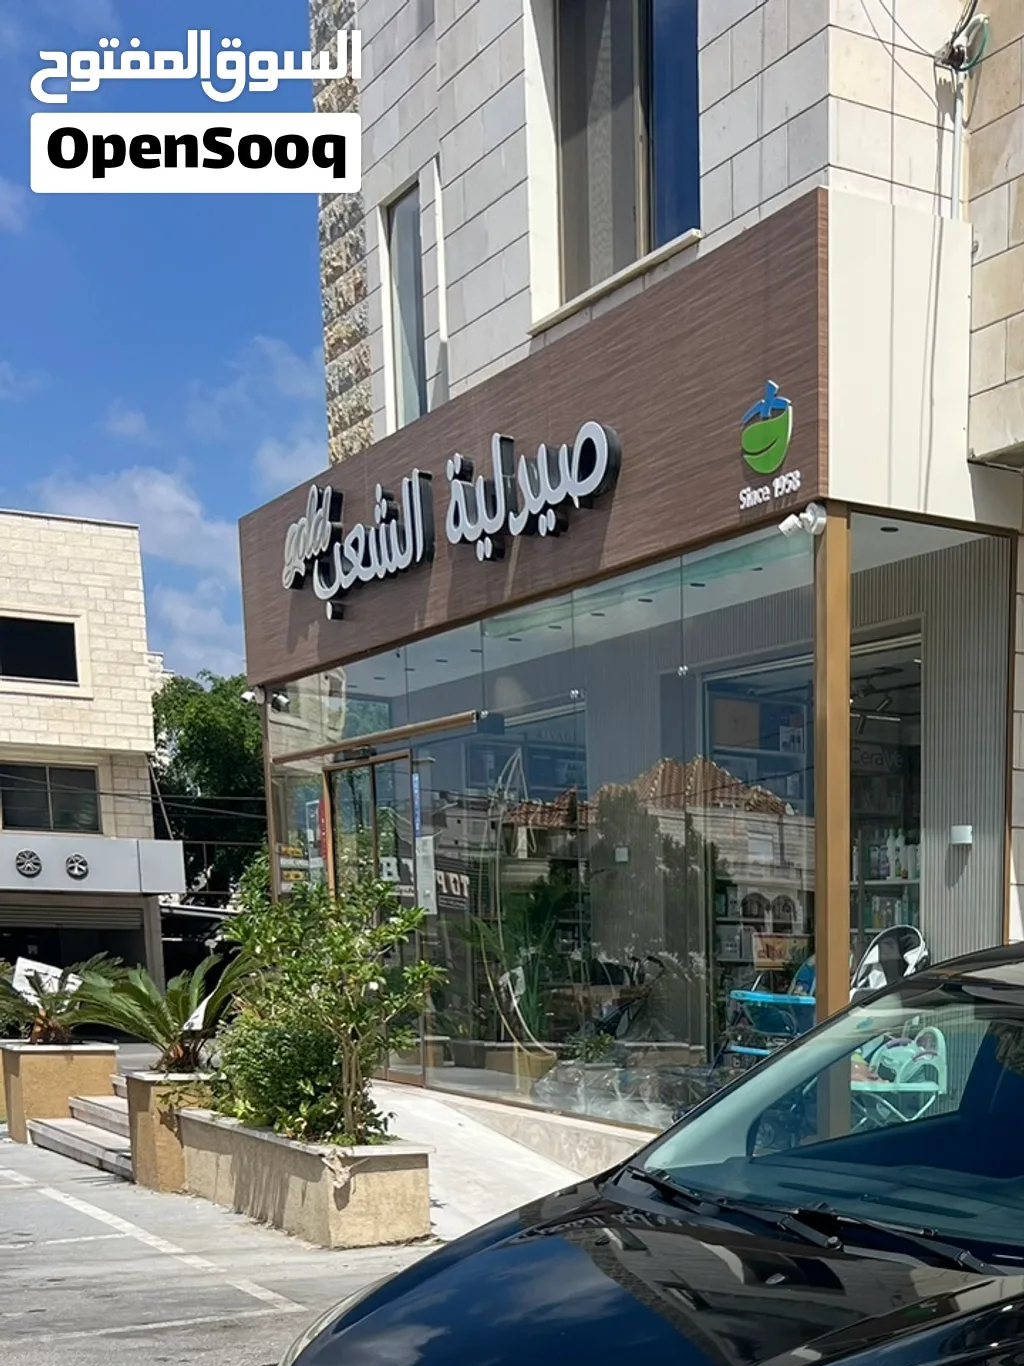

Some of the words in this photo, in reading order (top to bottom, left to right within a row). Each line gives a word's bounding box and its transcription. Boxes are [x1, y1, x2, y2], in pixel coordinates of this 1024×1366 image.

[313, 467, 424, 621] الشعب
[446, 420, 609, 562] صيدلية
[739, 486, 771, 510] Since
